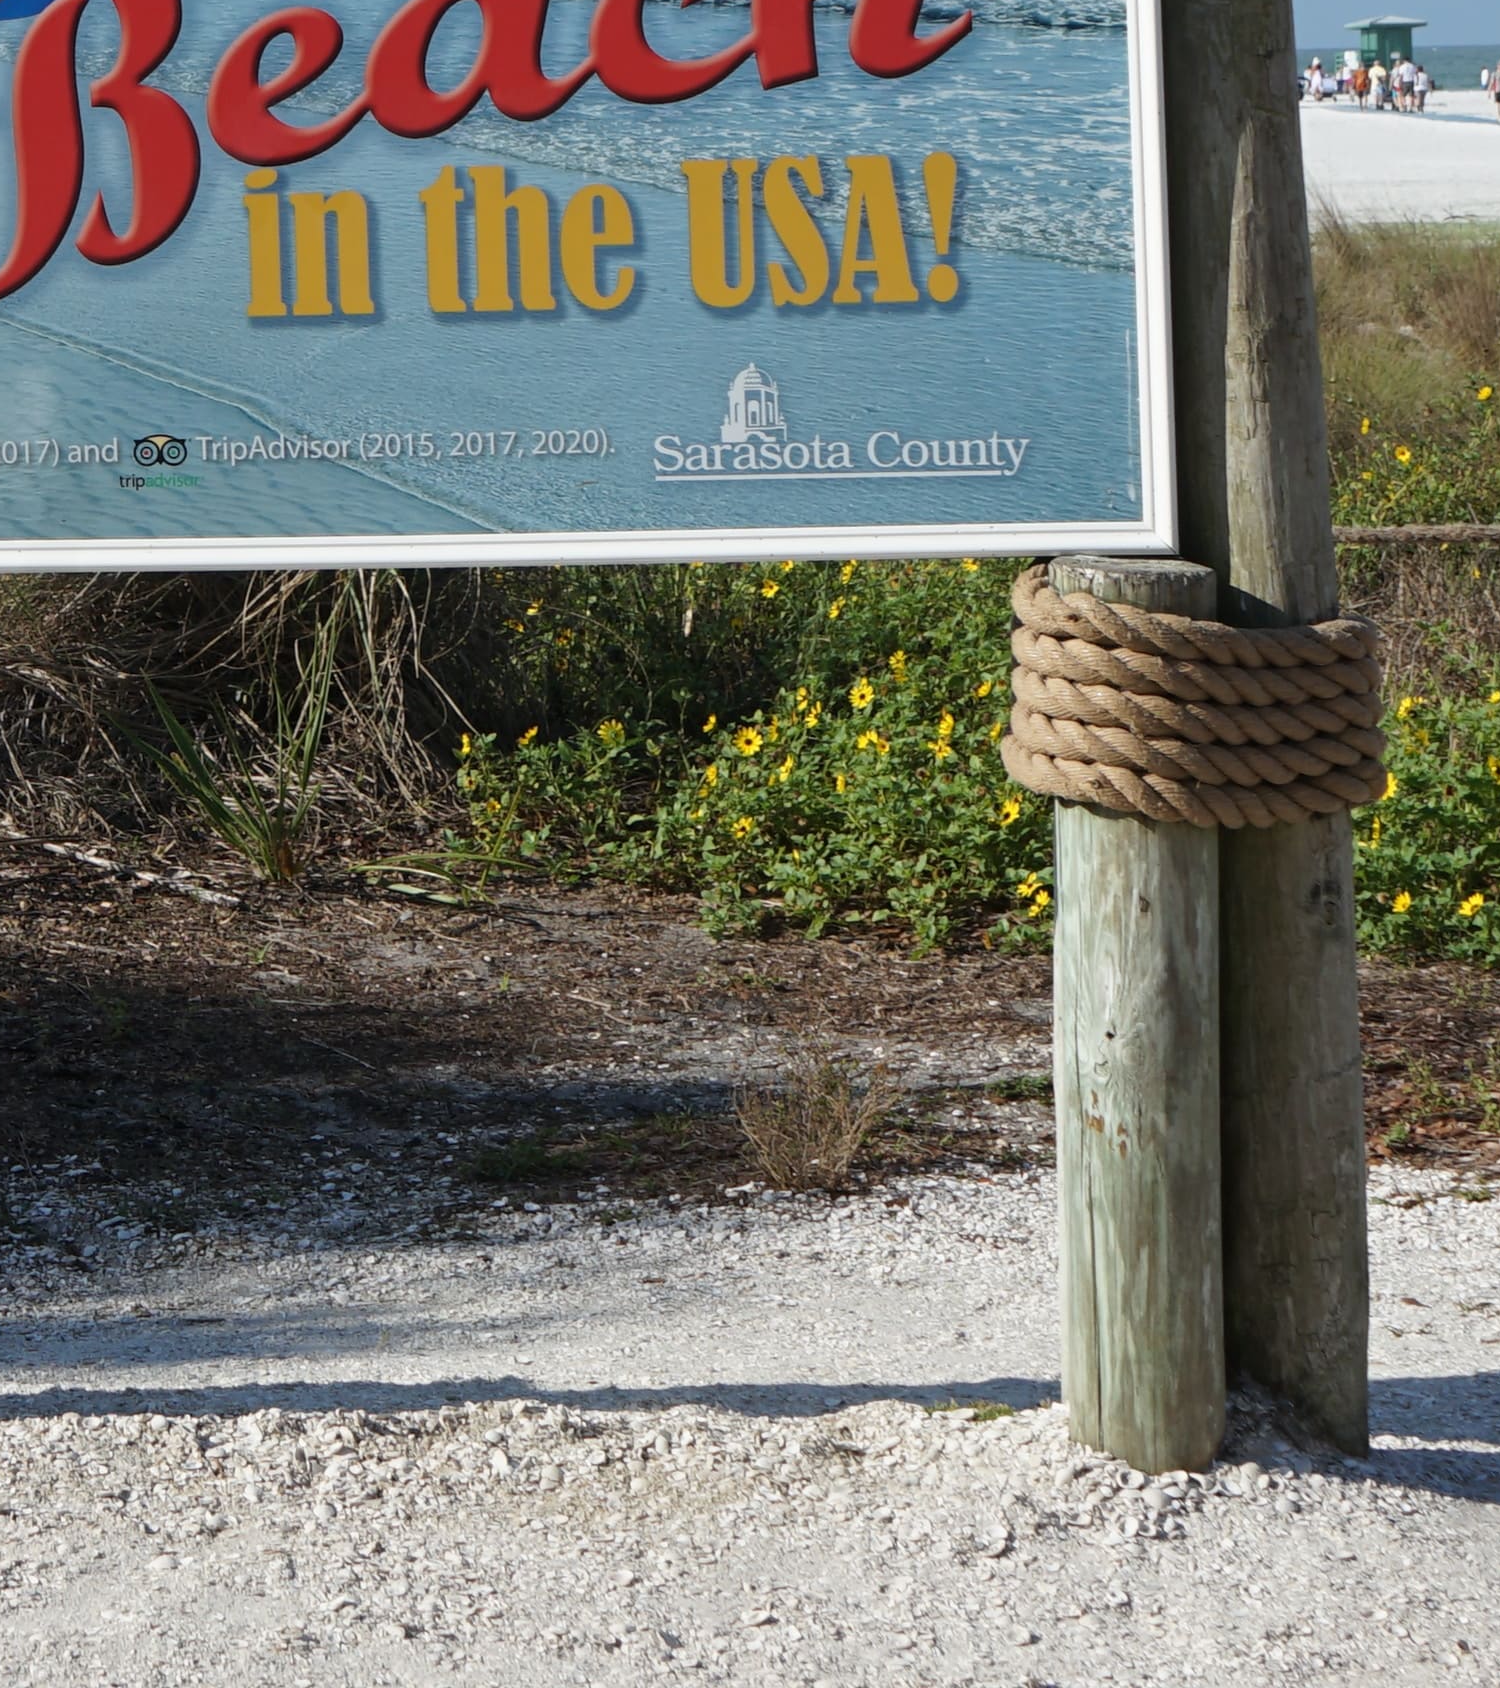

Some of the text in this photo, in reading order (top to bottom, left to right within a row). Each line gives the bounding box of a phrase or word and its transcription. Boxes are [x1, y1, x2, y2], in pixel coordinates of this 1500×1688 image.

[243, 151, 960, 317] in the USA!
[67, 437, 119, 463] and
[196, 434, 351, 466] TripAdvisor
[358, 432, 442, 462] (2015,
[449, 430, 524, 459] 2017,
[531, 428, 616, 458] 2020).
[653, 430, 1030, 476] Sarasota County
[119, 473, 201, 490] tripadvisor
